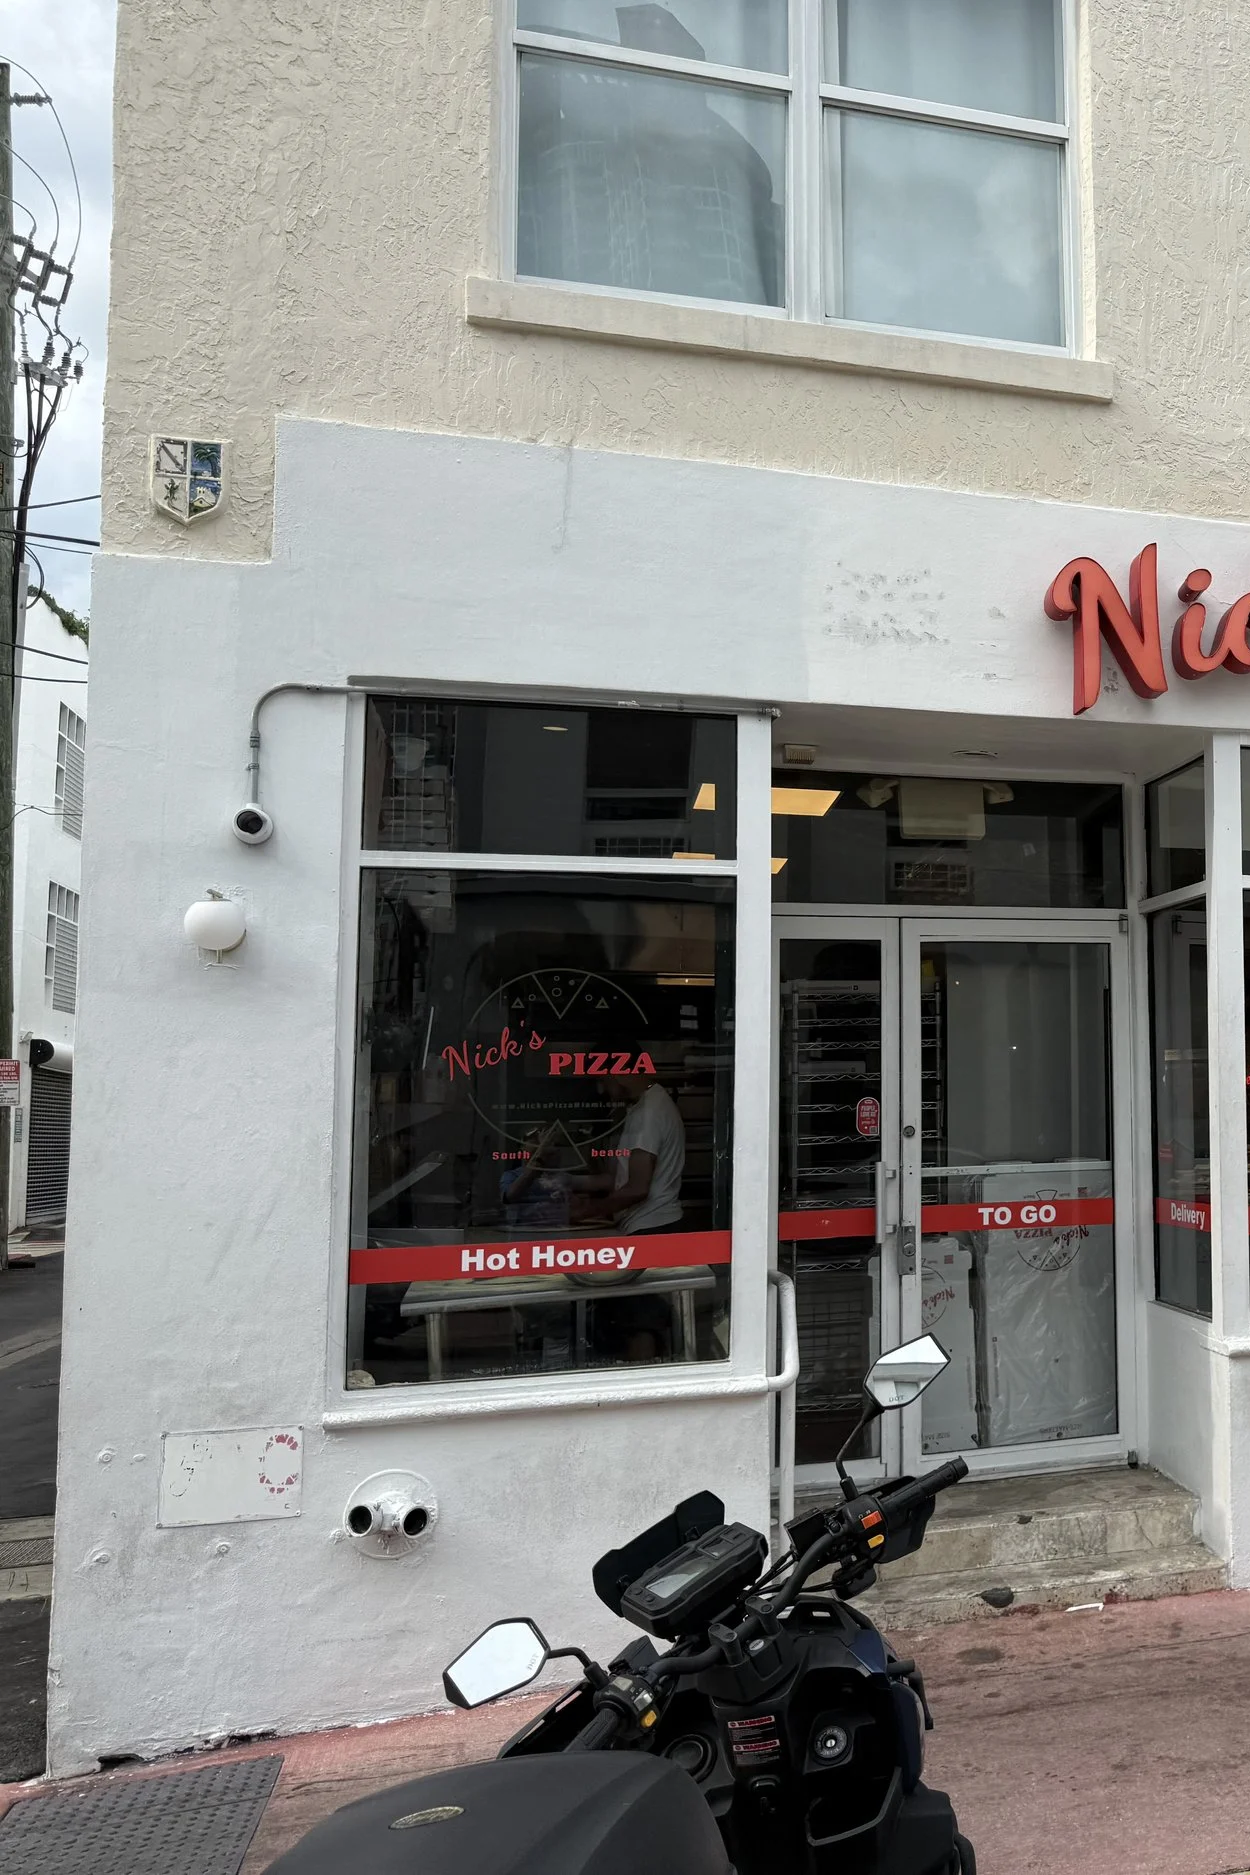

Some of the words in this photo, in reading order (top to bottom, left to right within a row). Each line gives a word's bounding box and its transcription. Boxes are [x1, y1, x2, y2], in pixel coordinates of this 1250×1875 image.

[441, 1019, 547, 1082] Nick's
[549, 1052, 656, 1075] PIZZA
[492, 1150, 531, 1160] South
[591, 1148, 631, 1157] beach
[978, 1206, 1012, 1226] TO
[1020, 1204, 1056, 1224] GO
[1170, 1202, 1205, 1230] Delivery
[461, 1248, 520, 1272] Hot
[532, 1245, 635, 1269] Honey
